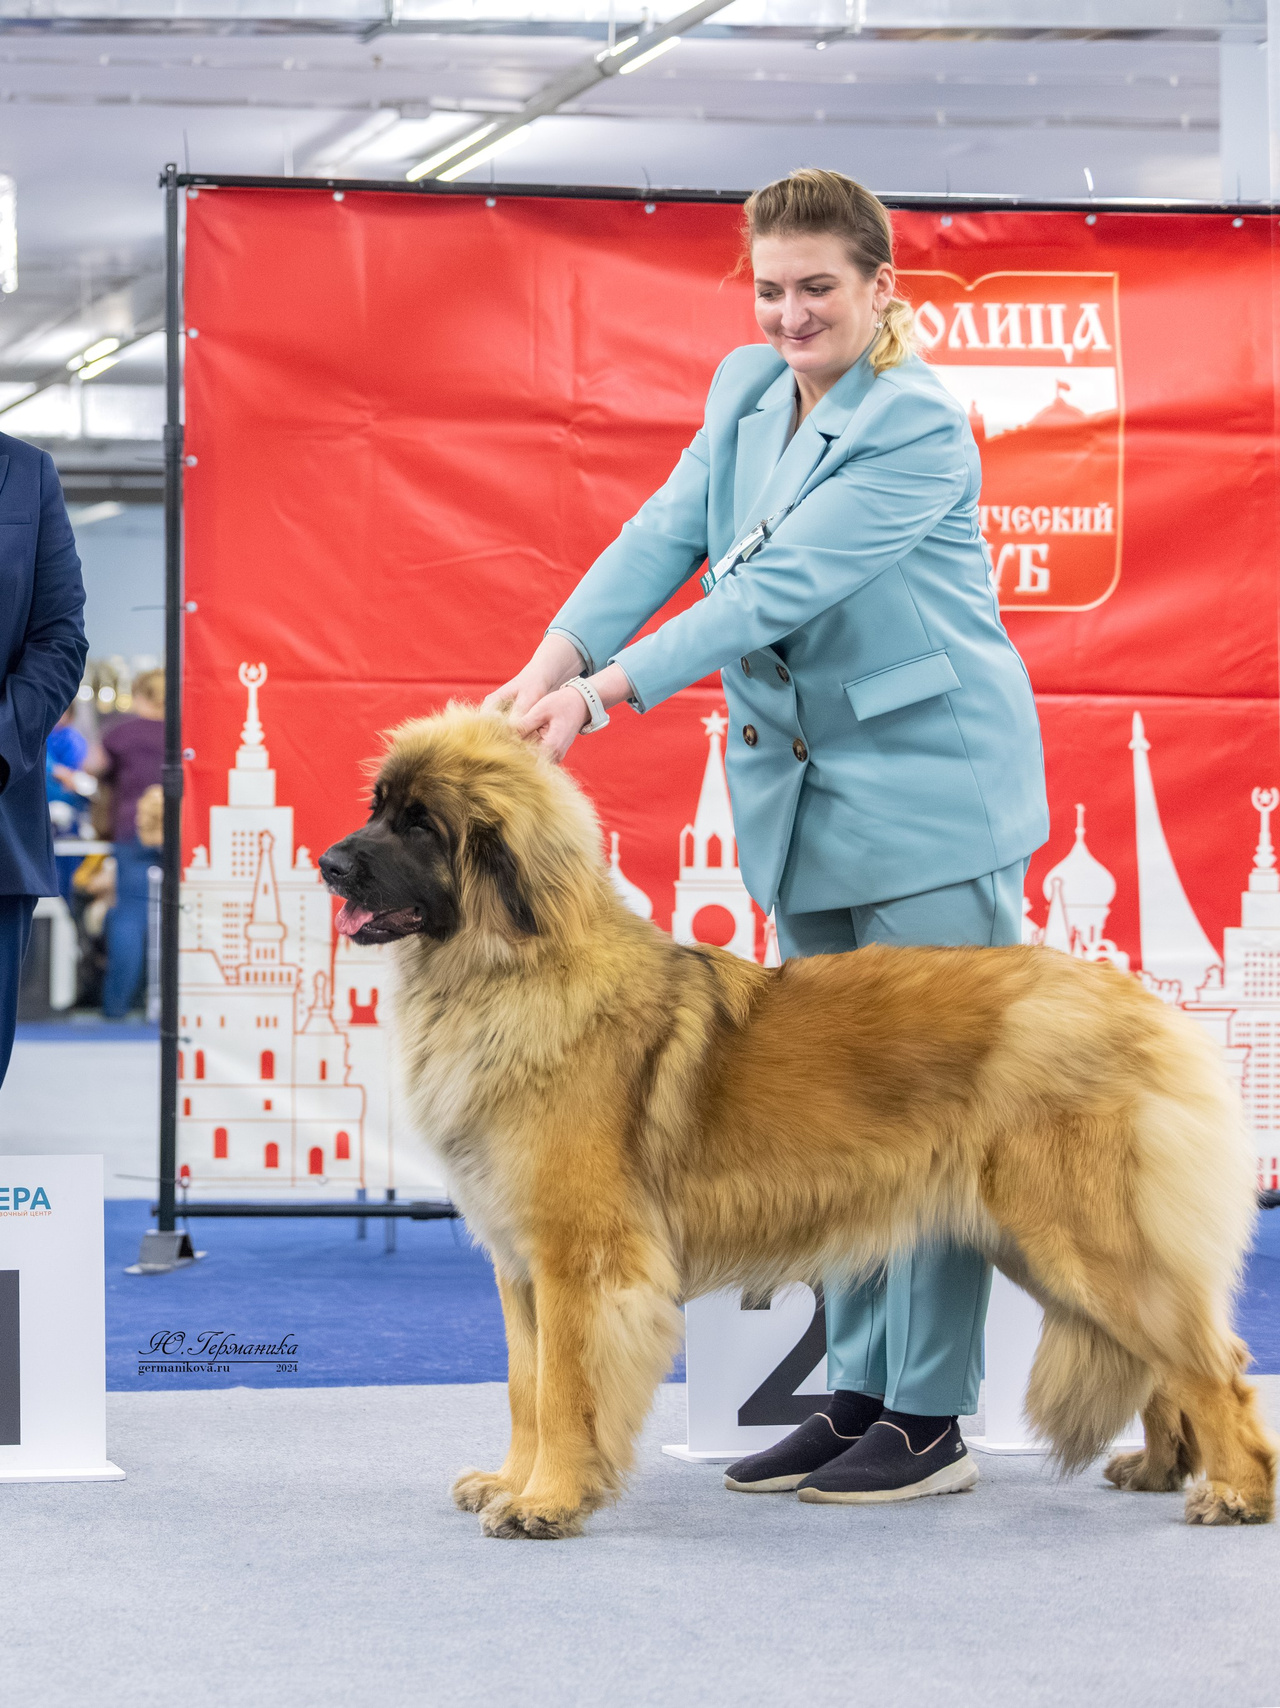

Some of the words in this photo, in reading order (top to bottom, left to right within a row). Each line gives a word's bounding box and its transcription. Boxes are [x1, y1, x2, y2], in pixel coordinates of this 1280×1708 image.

[914, 300, 1111, 364] ОЛИЦА
[980, 502, 1115, 534] ЧЕСКИЙ
[987, 543, 1050, 593] УБ
[29, 1210, 52, 1218] ЦЕНТР
